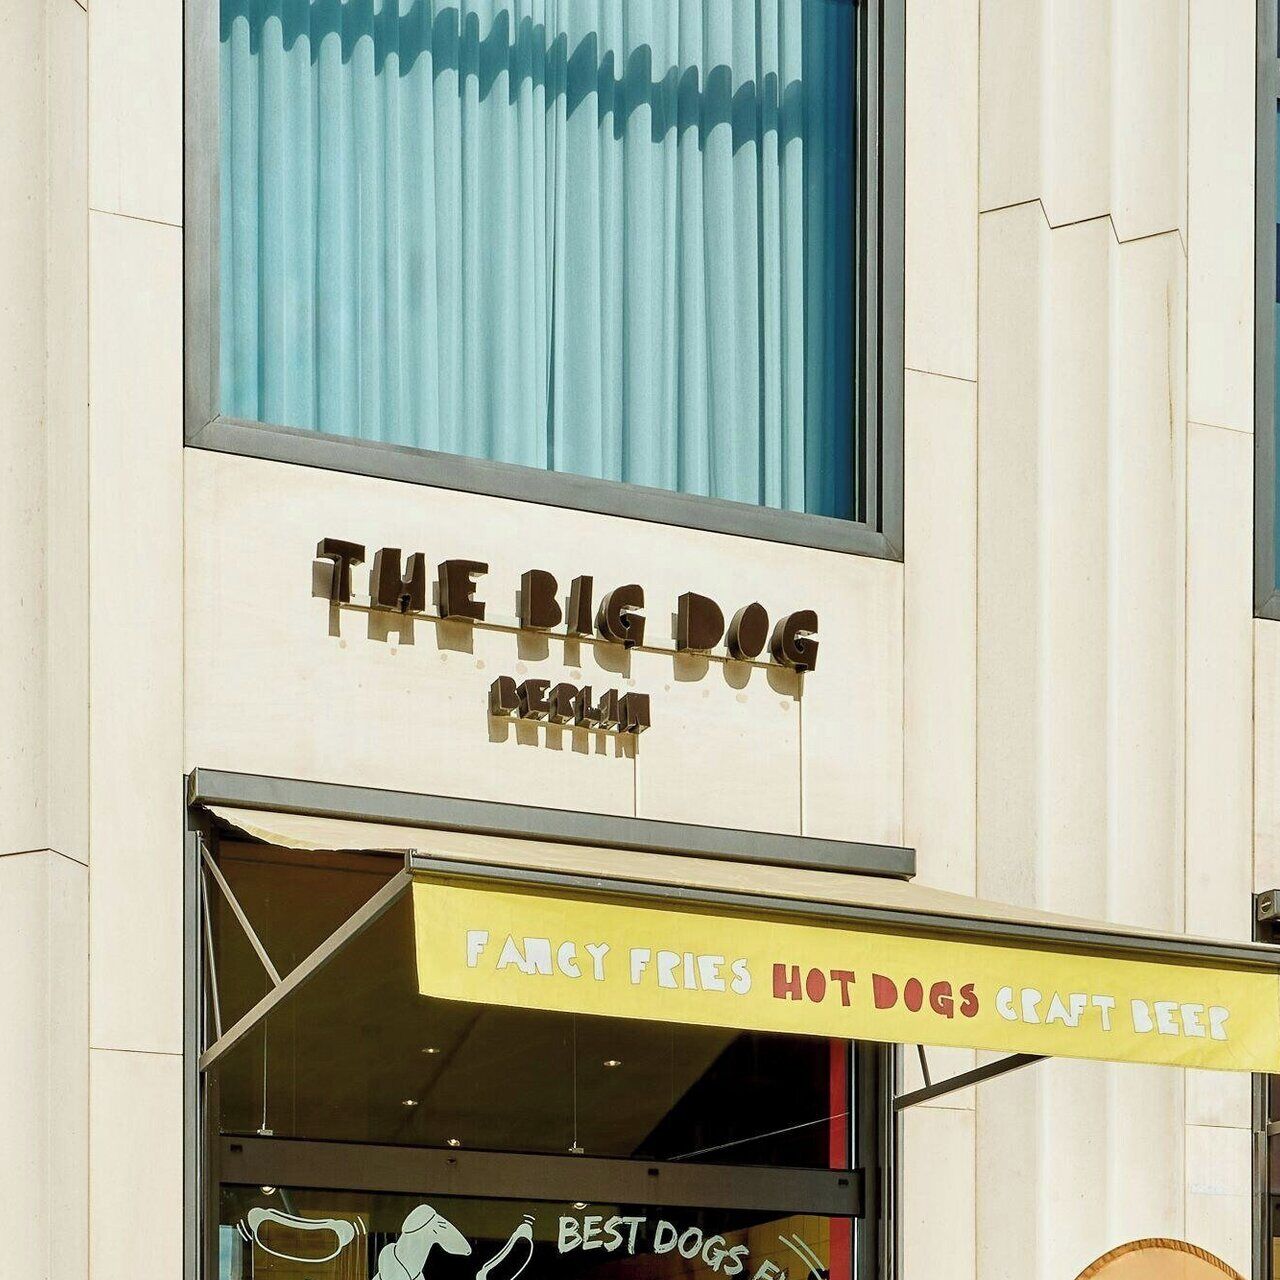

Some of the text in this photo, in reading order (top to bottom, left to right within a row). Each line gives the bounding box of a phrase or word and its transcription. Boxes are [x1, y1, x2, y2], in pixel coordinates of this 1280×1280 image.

[316, 537, 818, 671] THE BIG DOG
[490, 675, 650, 734] BERLIN
[466, 929, 1231, 1040] FANCY FRIES HOT DOGS CRAFT BEER
[558, 1216, 646, 1254] BEST
[654, 1220, 749, 1276] DOGS
